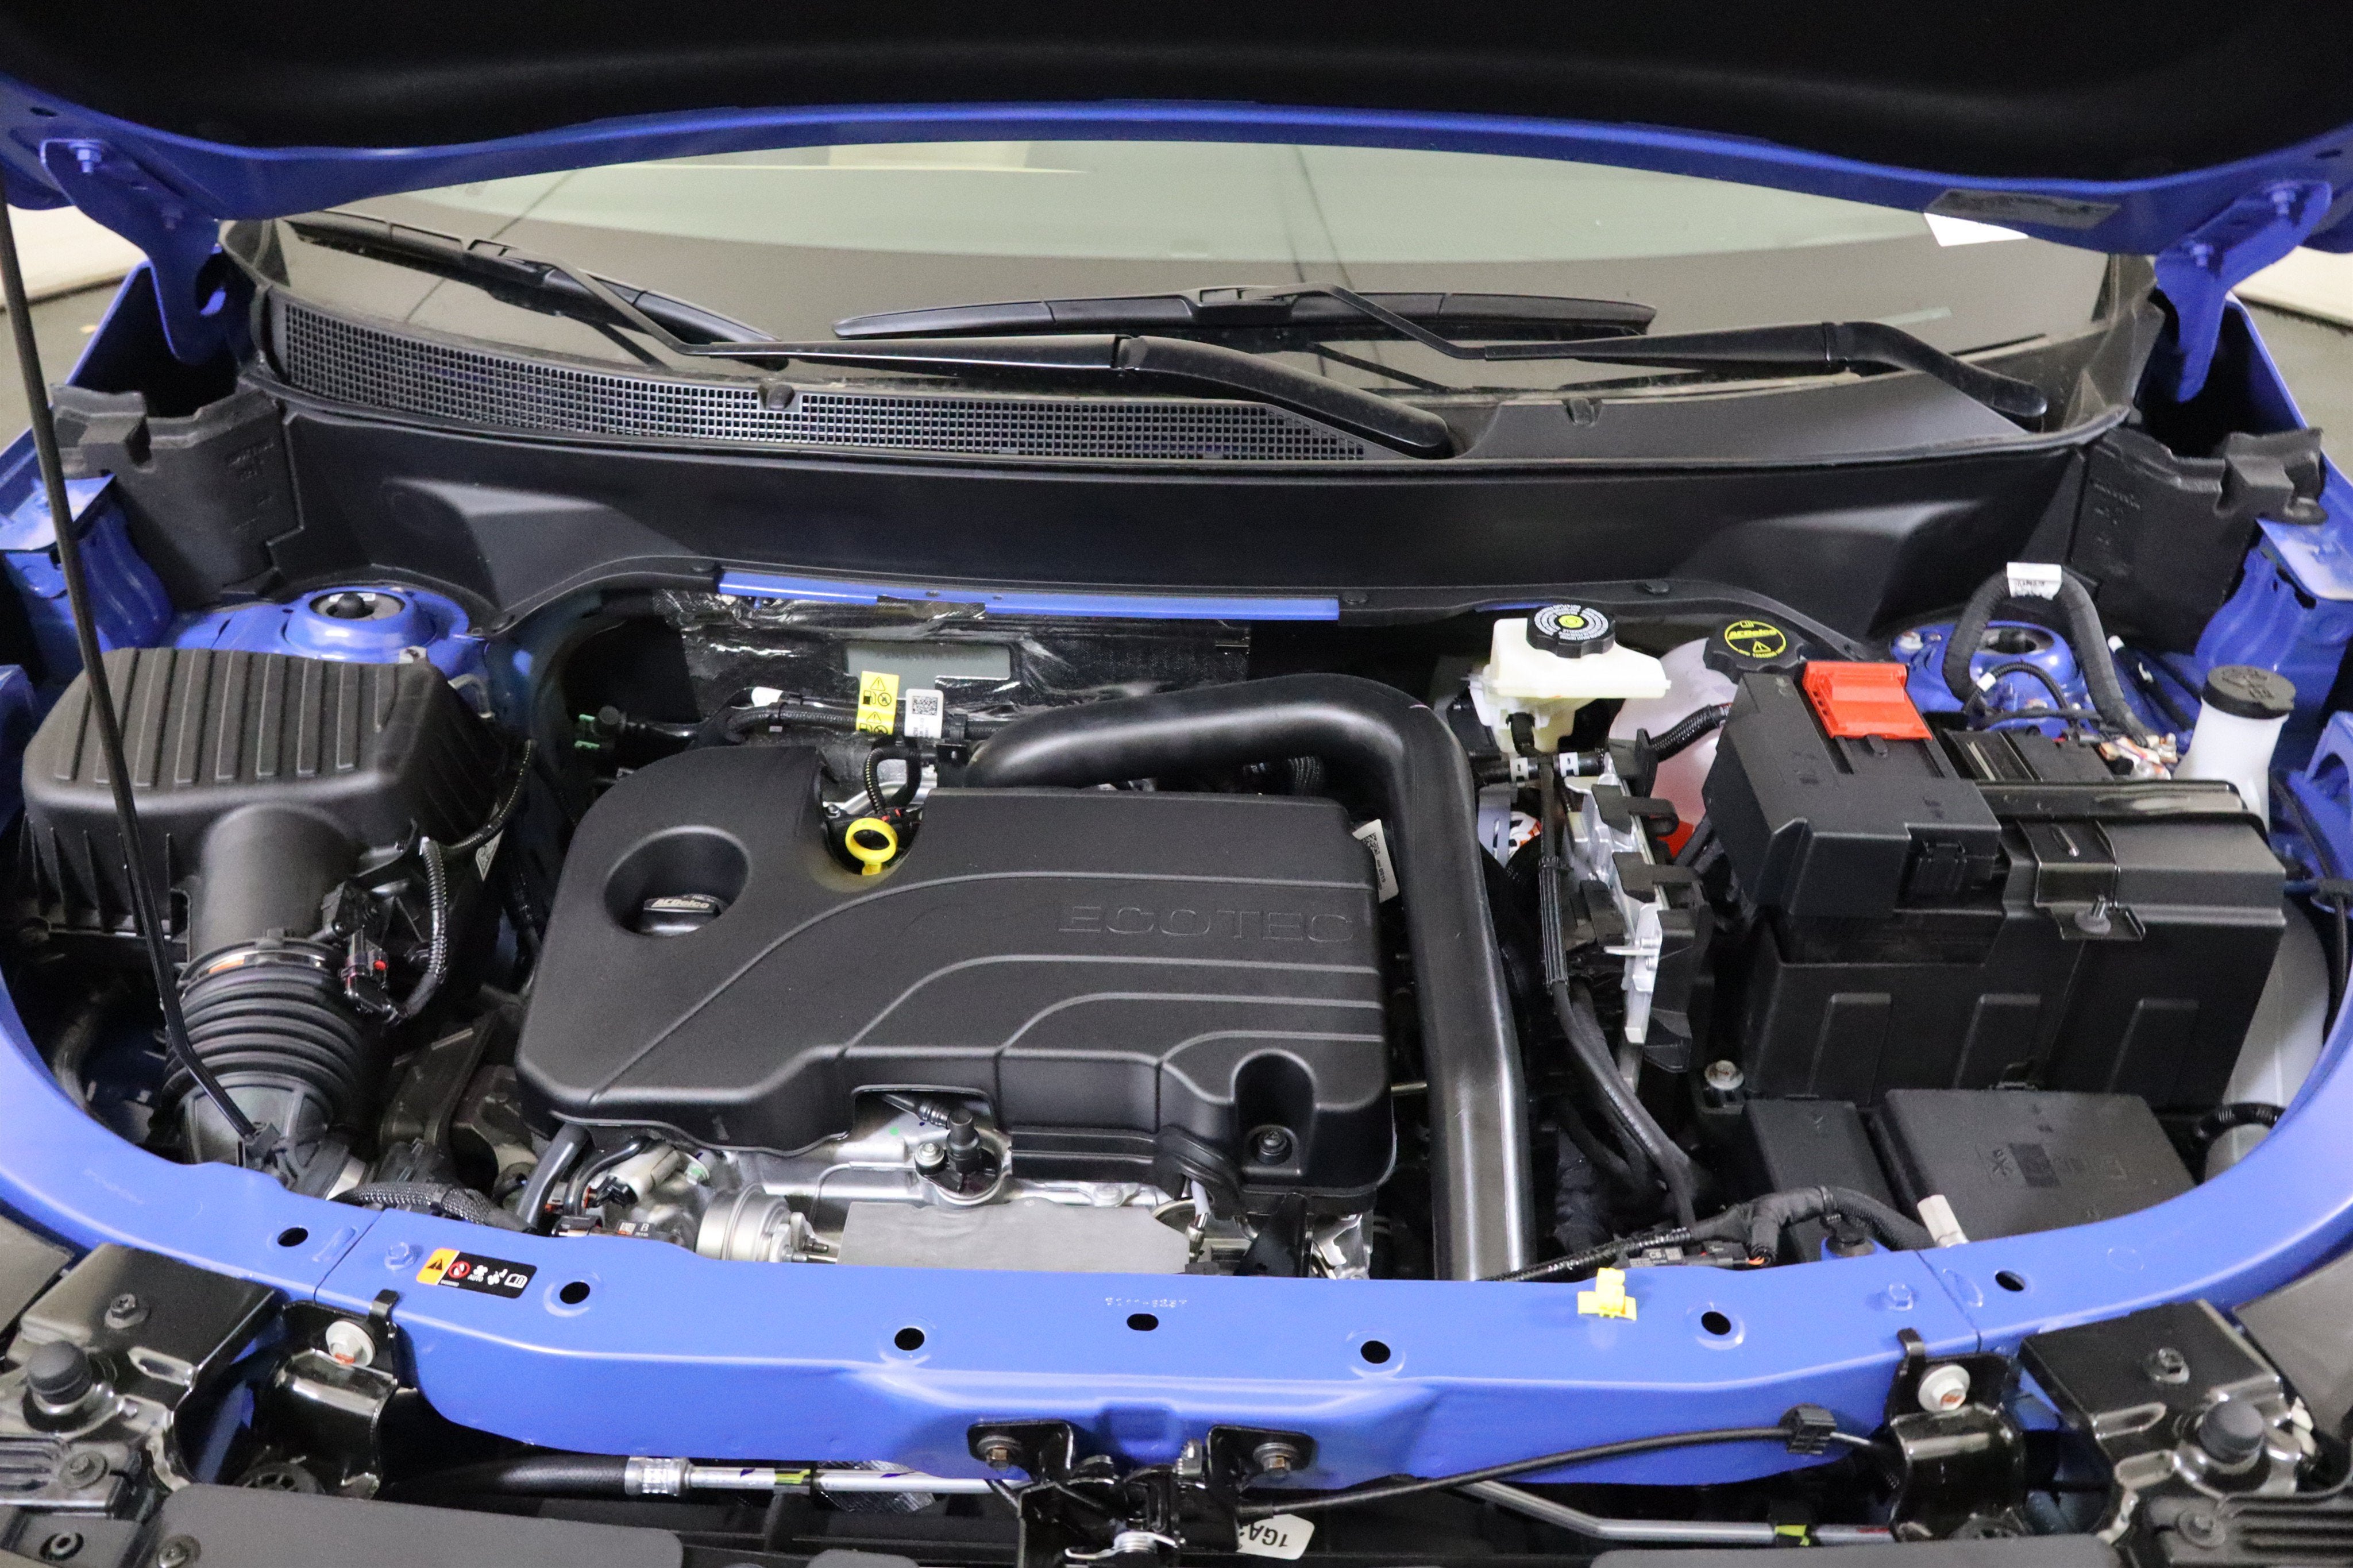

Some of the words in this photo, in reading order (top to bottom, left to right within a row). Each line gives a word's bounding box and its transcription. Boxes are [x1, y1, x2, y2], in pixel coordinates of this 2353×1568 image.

[651, 898, 710, 909] ACDelco
[1059, 906, 1353, 943] ECOTEC
[467, 1273, 484, 1283] AUTO
[1239, 1523, 1289, 1547] 1GA
